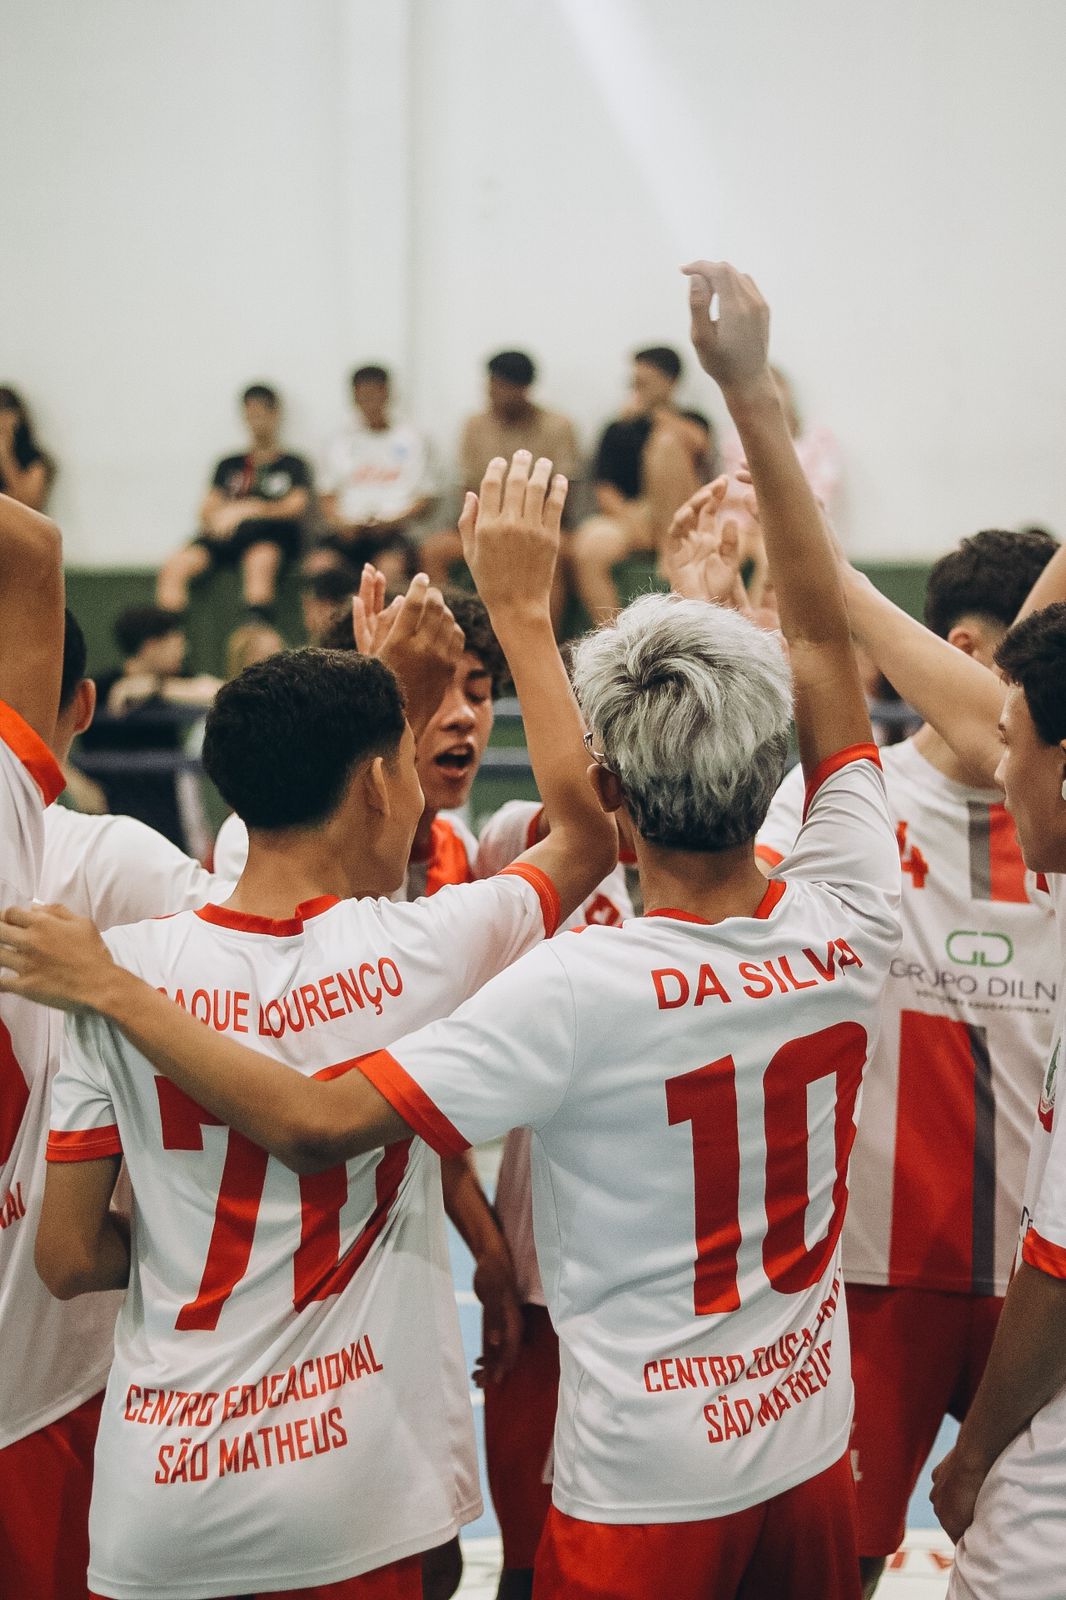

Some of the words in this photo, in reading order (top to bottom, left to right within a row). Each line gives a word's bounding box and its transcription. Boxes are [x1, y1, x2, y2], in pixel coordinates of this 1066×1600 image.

[258, 956, 404, 1039] LOURENÇO
[651, 963, 731, 1010] DA
[738, 937, 863, 999] SILVA
[664, 1021, 868, 1316] 10
[124, 1383, 220, 1427] CENTRO
[222, 1334, 384, 1424] EDUCACIONAL
[643, 1353, 746, 1393] CENTRO
[154, 1437, 209, 1485] SÃO
[218, 1406, 349, 1478] MATHEUS
[703, 1394, 755, 1444] SÃO
